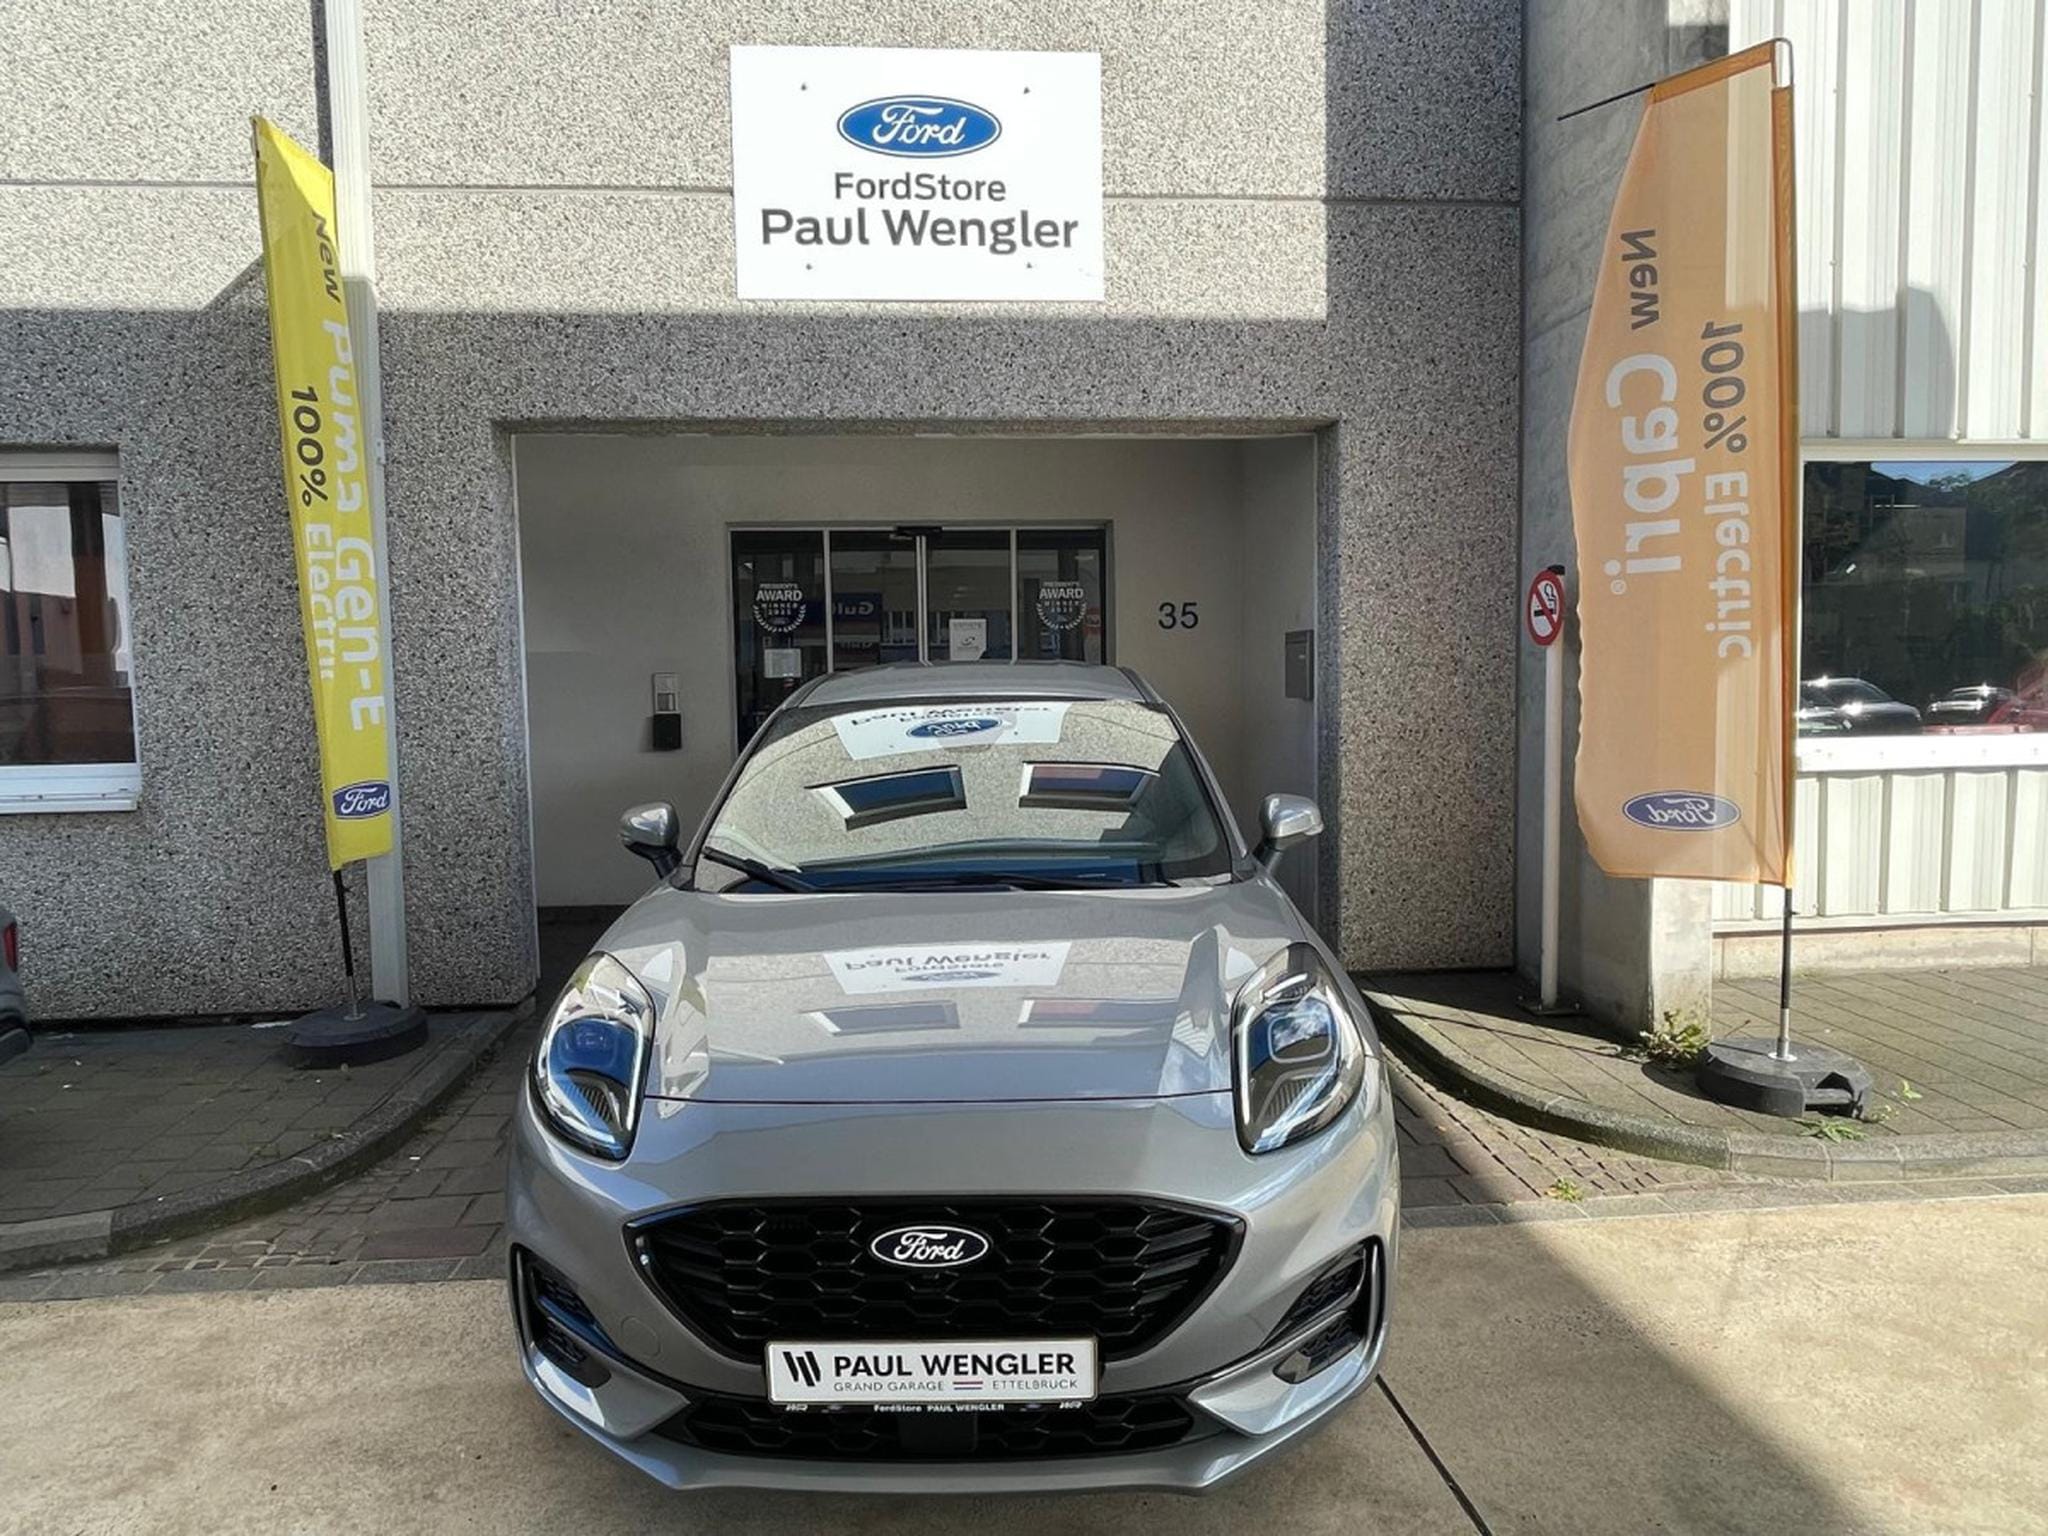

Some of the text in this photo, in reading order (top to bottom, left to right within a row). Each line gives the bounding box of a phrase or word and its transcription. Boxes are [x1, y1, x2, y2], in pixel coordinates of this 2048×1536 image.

[872, 104, 967, 145] Ford
[835, 172, 1007, 201] FordStore
[761, 208, 1079, 255] Paul Wengler
[291, 386, 329, 507] 100%
[312, 212, 342, 304] New
[334, 536, 386, 731] Gen-E
[756, 590, 803, 601] AWARD
[1039, 588, 1084, 600] AWARD
[1158, 602, 1199, 630] 35
[340, 787, 388, 815] Ford
[893, 1231, 965, 1260] Ford
[834, 1353, 1076, 1377] PAUL WENGLER
[834, 1379, 1078, 1392] GRAND GARAGE ETTELBRUCK
[927, 1404, 953, 1412] PAUL
[955, 1403, 1005, 1411] WENGLER
